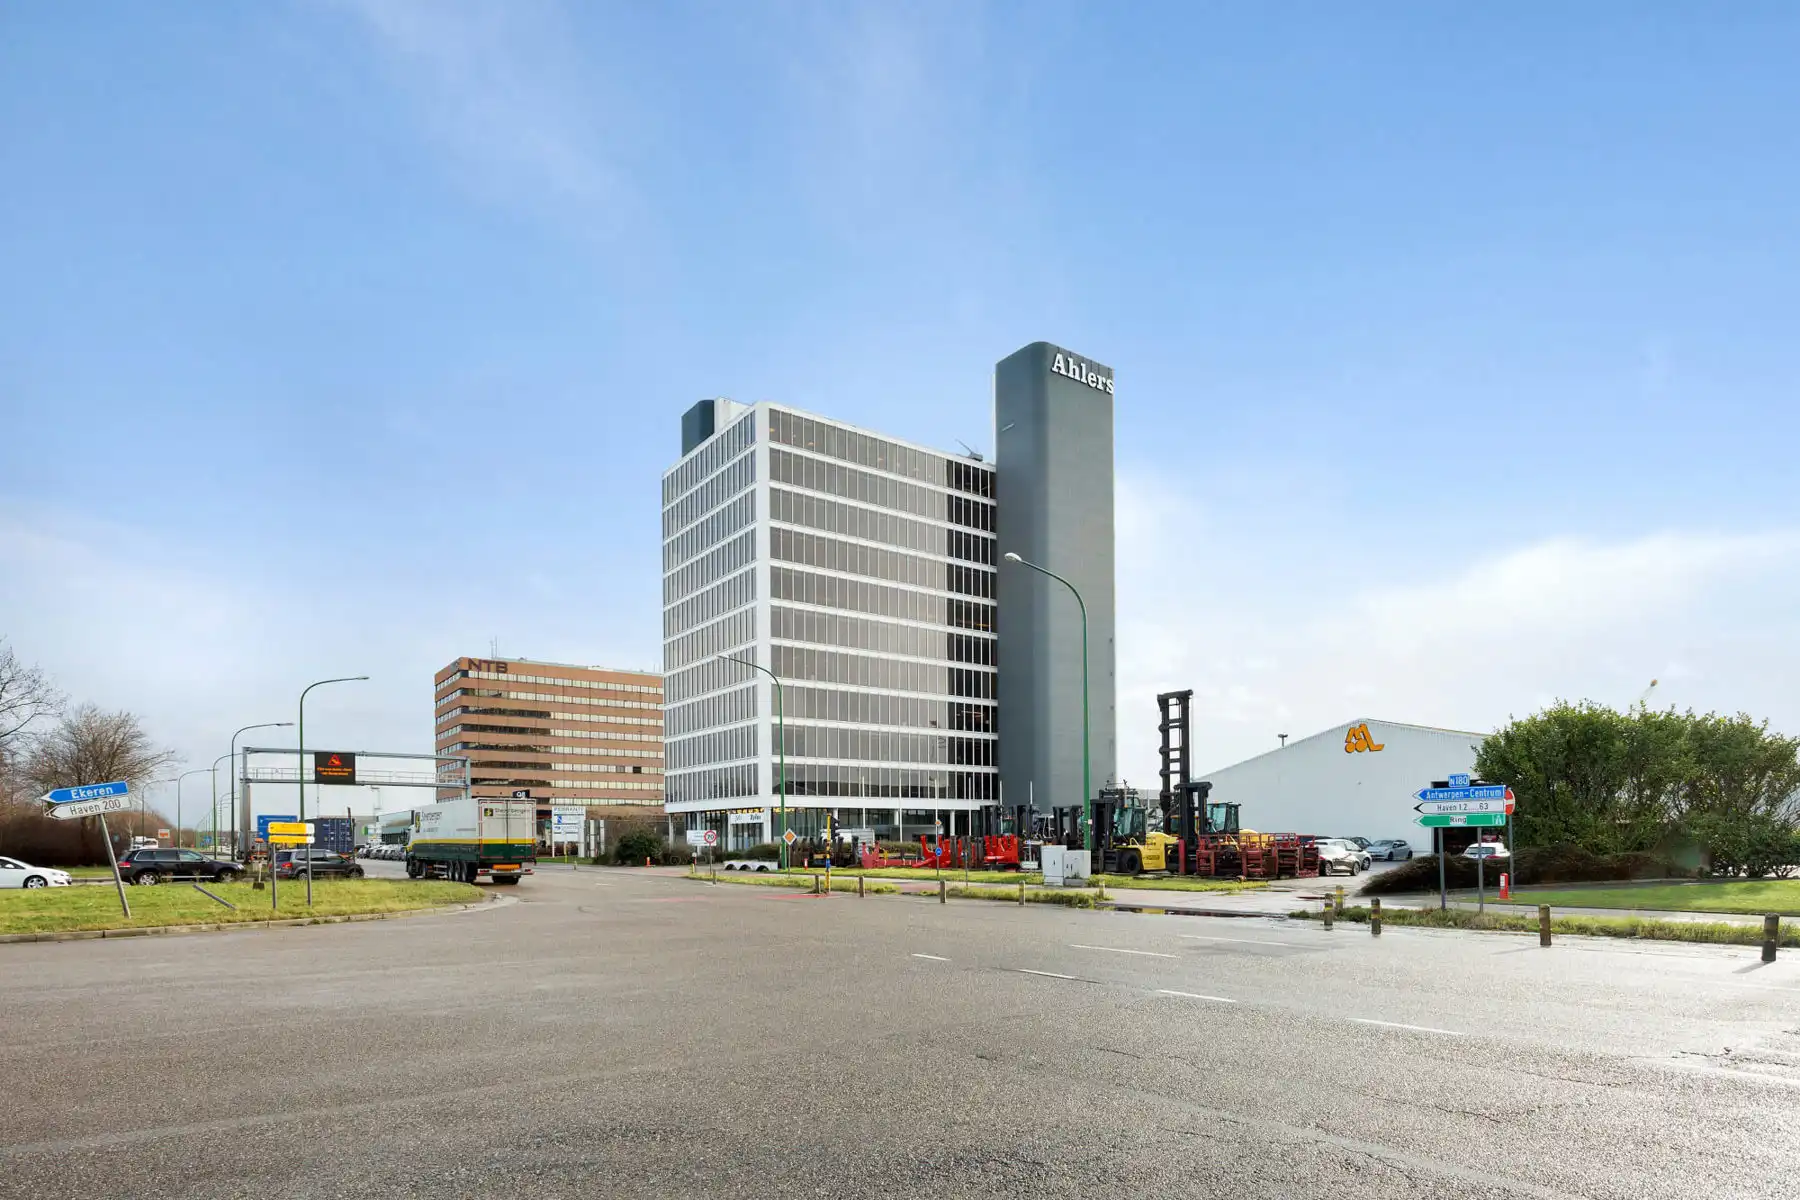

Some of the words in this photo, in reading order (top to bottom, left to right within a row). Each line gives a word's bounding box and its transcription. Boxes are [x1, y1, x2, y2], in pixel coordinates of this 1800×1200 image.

[1051, 353, 1114, 394] Ahlers
[468, 658, 508, 673] NTB
[70, 786, 114, 799] Ekeren
[1426, 788, 1502, 800] Antwerpen-Centrum
[69, 803, 100, 815] Haven
[102, 799, 121, 810] 200
[1450, 816, 1467, 824] Ring
